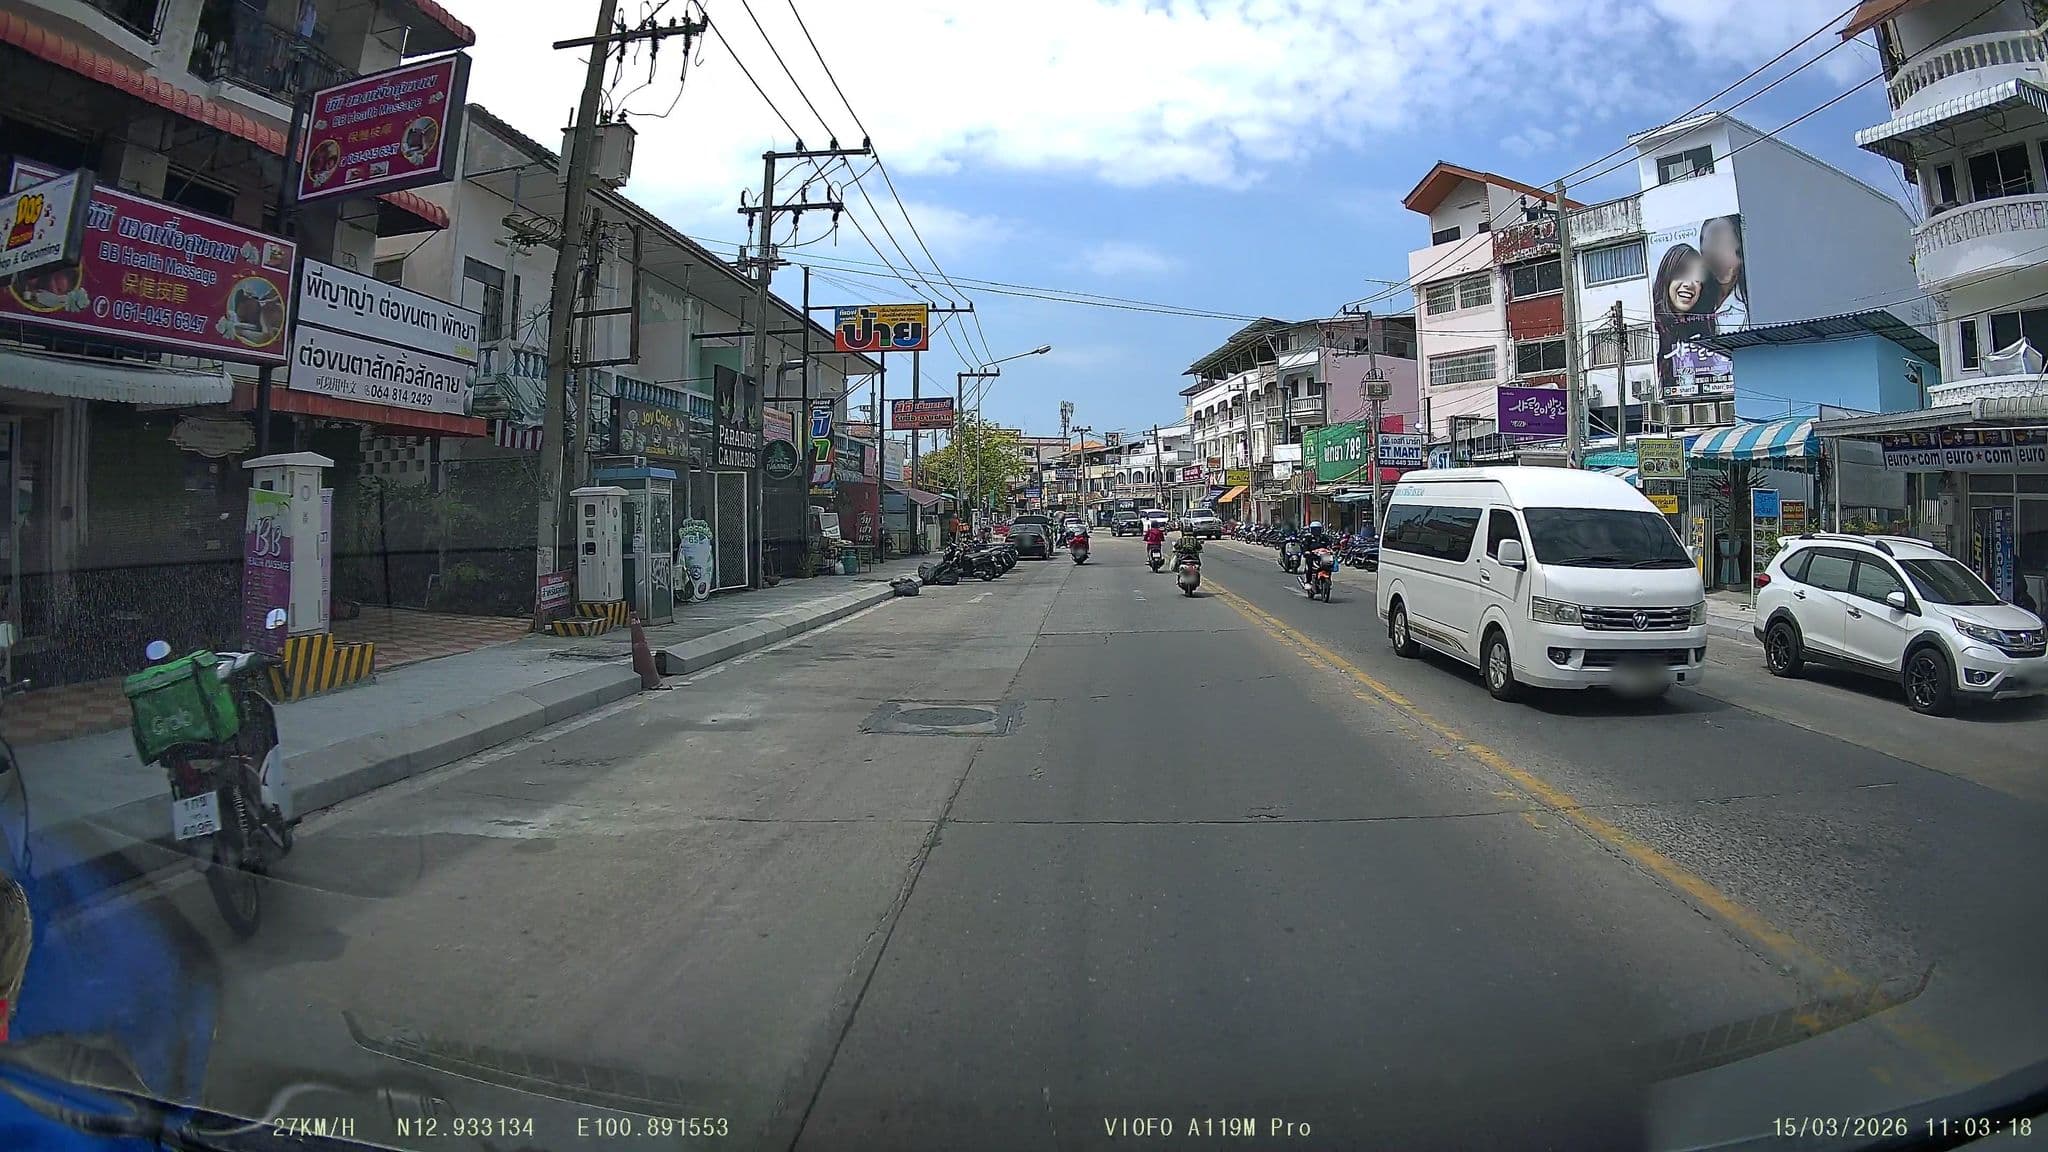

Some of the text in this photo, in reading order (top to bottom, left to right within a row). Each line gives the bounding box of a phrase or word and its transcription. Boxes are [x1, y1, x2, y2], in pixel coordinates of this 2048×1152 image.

[347, 108, 378, 124] Health
[379, 97, 423, 116] Massage
[99, 241, 217, 286] BB Health Massage
[113, 299, 209, 334] 061-045 6347
[306, 267, 477, 342] พี่ญาญ่า ต่อขนตา พัทยา
[843, 308, 922, 349] ป้าย
[299, 338, 460, 394] ต่อขนตาสักคิ้วสักลาย
[370, 384, 389, 400] 064
[391, 388, 408, 403] 814
[410, 391, 433, 406] 2429
[641, 411, 655, 425] Joy
[719, 425, 757, 449] PARADISE
[718, 446, 756, 468] CANNABIS
[1345, 437, 1361, 462] 789
[1380, 448, 1420, 458] ST MART
[1887, 452, 1941, 467] euro com
[1946, 448, 2013, 464] euro com
[2019, 447, 2046, 463] euro
